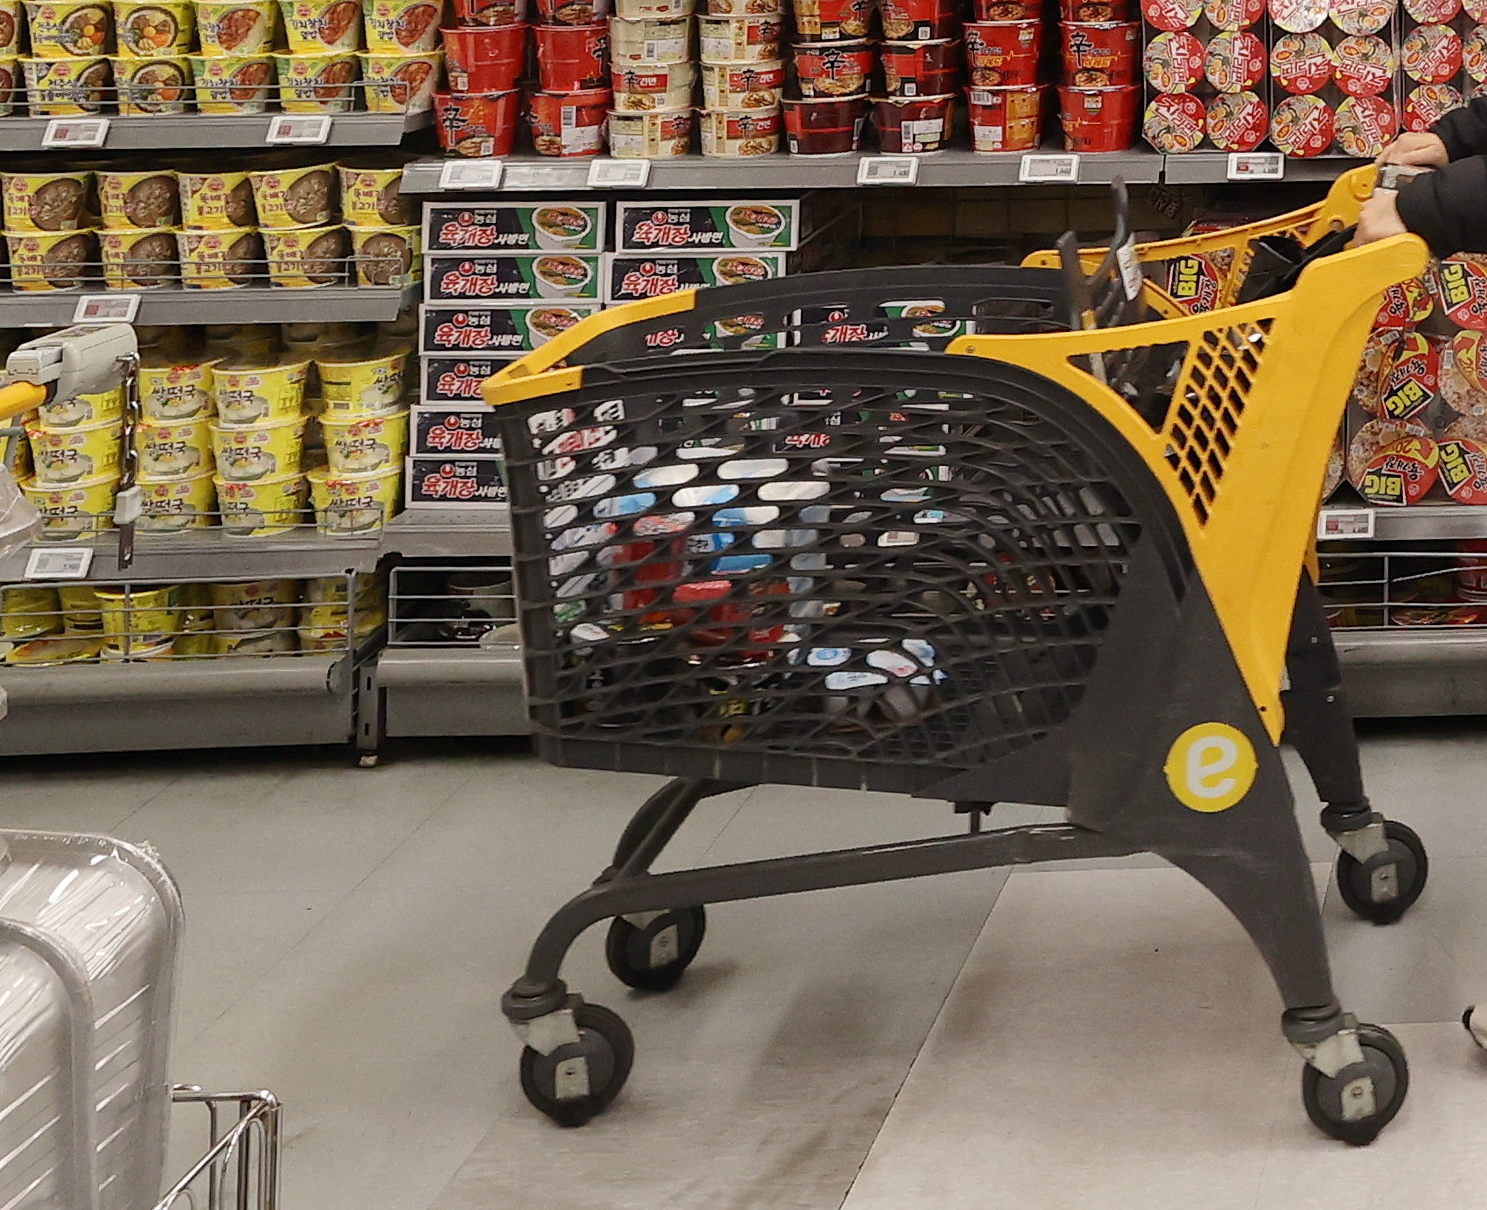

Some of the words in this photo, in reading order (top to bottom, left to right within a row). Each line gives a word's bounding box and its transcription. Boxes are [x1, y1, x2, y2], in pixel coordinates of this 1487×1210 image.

[451, 225, 496, 247] 육개장
[635, 225, 689, 247] 육개장
[443, 273, 496, 294] 육개장
[1172, 257, 1201, 298] BIG
[1441, 261, 1467, 305] BIG
[426, 428, 483, 450] 육개장
[422, 477, 476, 499] 육개장
